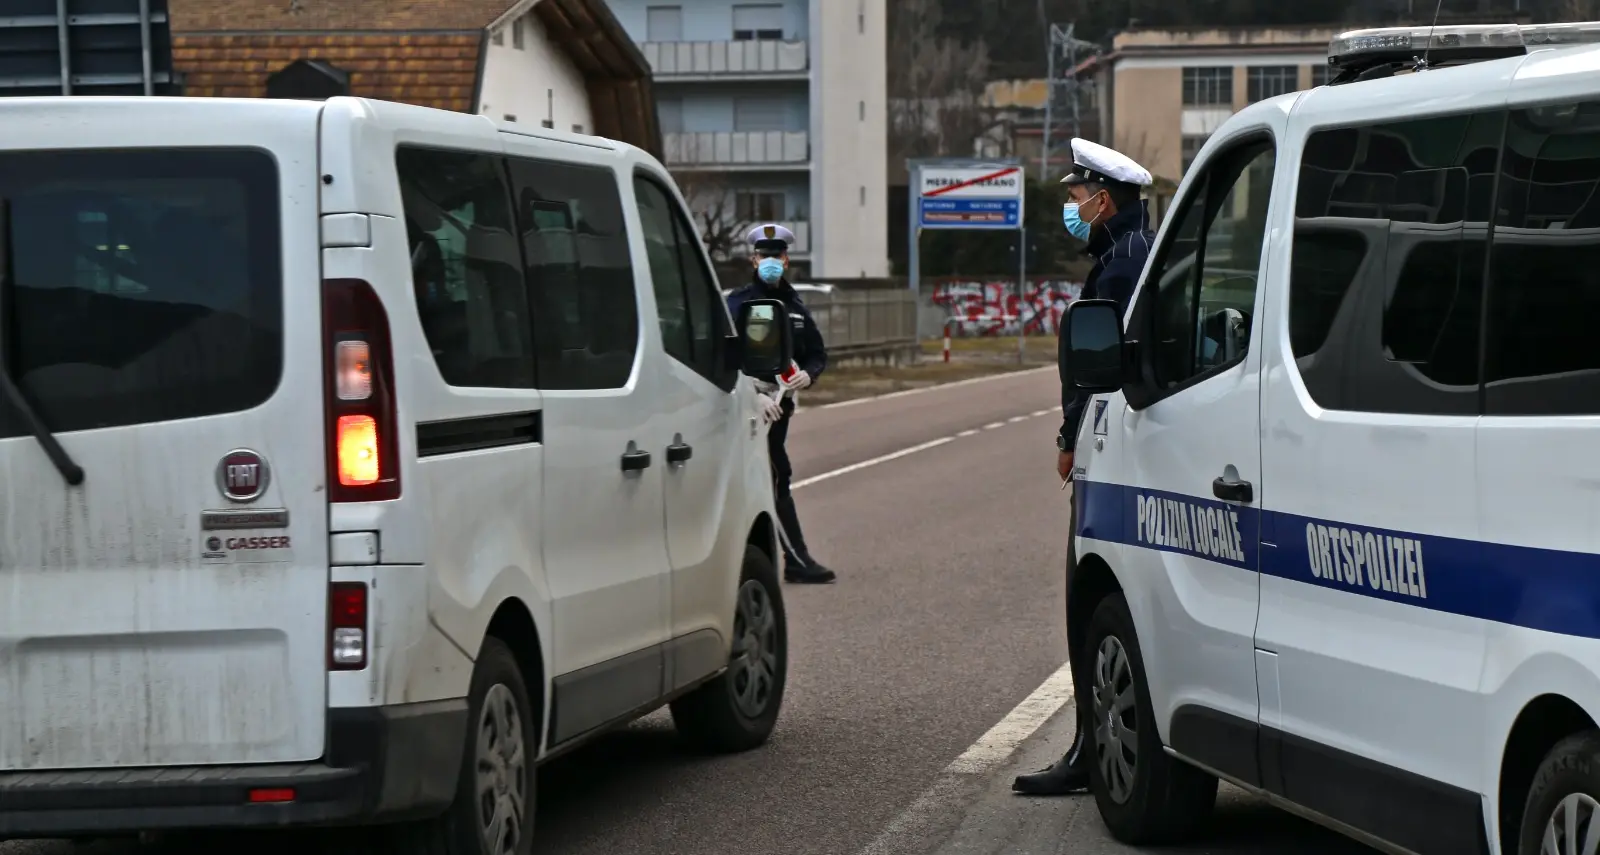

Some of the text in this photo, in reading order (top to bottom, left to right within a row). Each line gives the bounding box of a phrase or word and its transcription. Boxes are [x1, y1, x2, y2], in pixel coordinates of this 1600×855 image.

[926, 177, 963, 187] MERAN
[227, 463, 259, 487] FIAT
[1137, 494, 1193, 551] POLIZIA
[225, 536, 291, 550] GASSER
[1306, 522, 1427, 599] ORTSPOLIZEI
